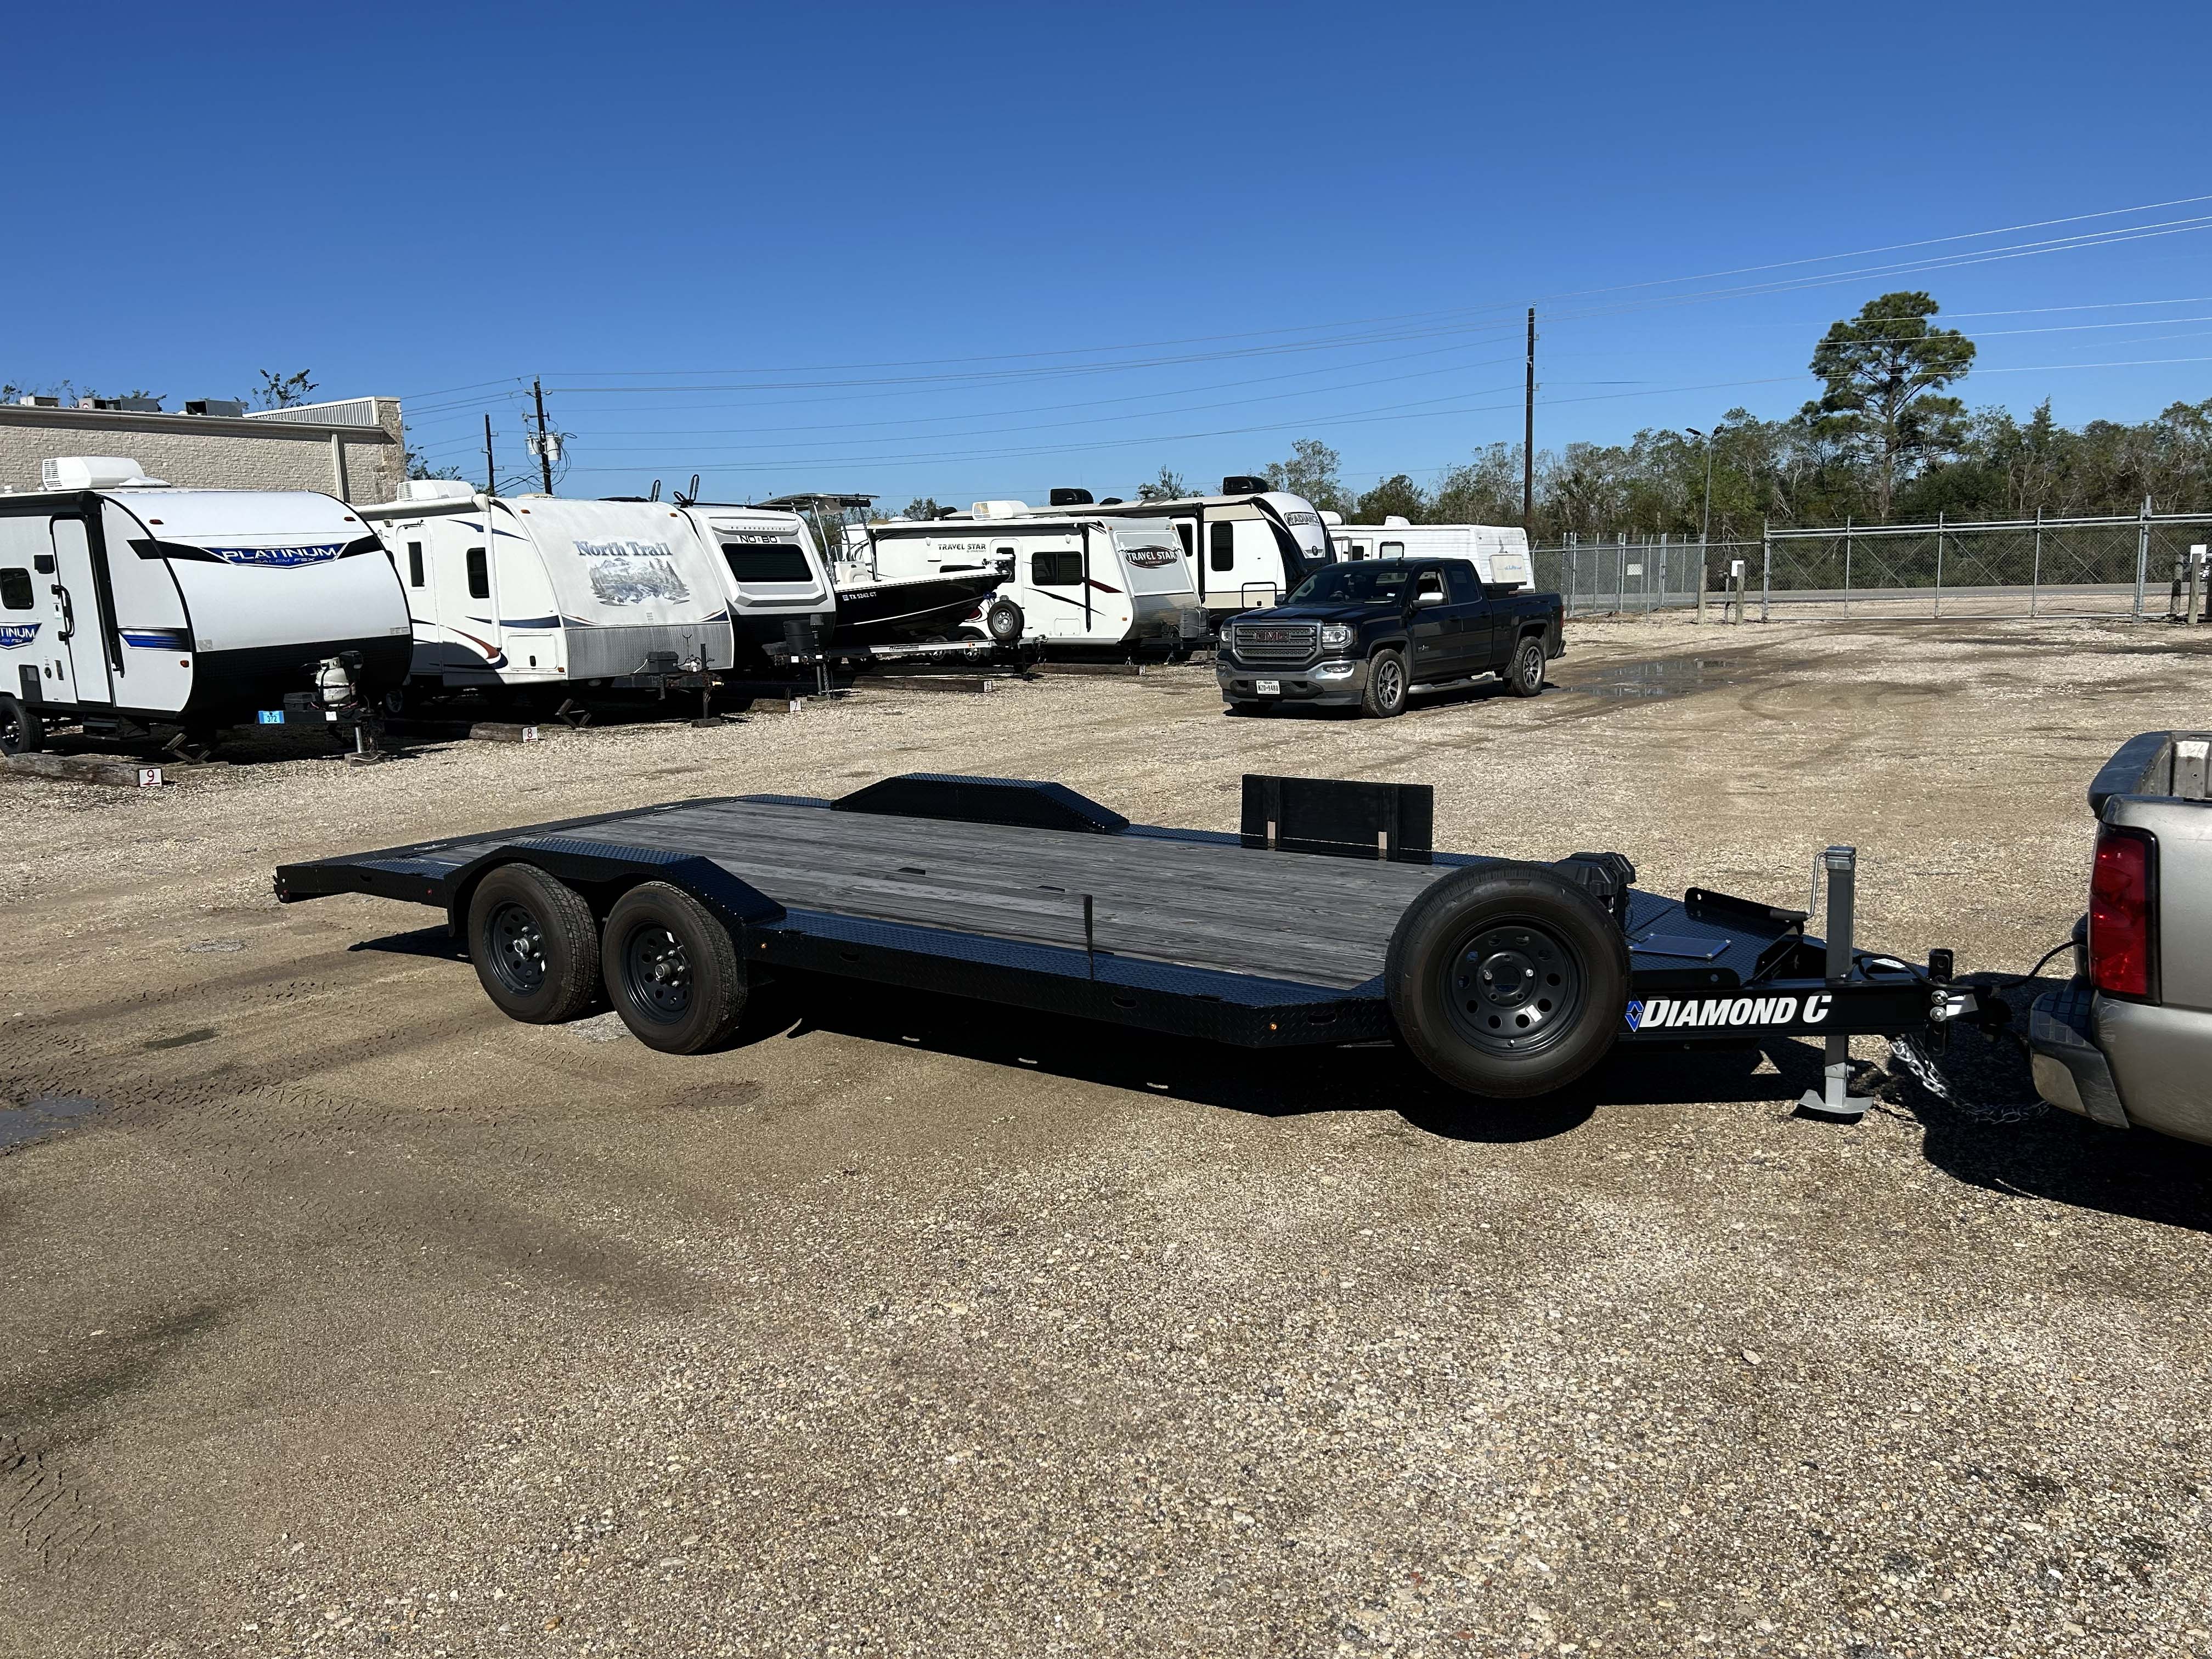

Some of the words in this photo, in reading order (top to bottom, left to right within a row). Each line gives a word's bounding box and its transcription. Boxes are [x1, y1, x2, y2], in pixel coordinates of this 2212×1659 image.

[221, 548, 337, 560] PLATINUM
[572, 541, 629, 556] North
[625, 541, 673, 556] Trail
[1127, 552, 1155, 561] TRAVEL
[1156, 551, 1178, 560] STAR
[1255, 632, 1289, 641] GMC
[527, 728, 533, 738] 8
[146, 770, 155, 782] 9
[1639, 996, 1797, 1028] DIAMOND
[1803, 991, 1832, 1023] C
